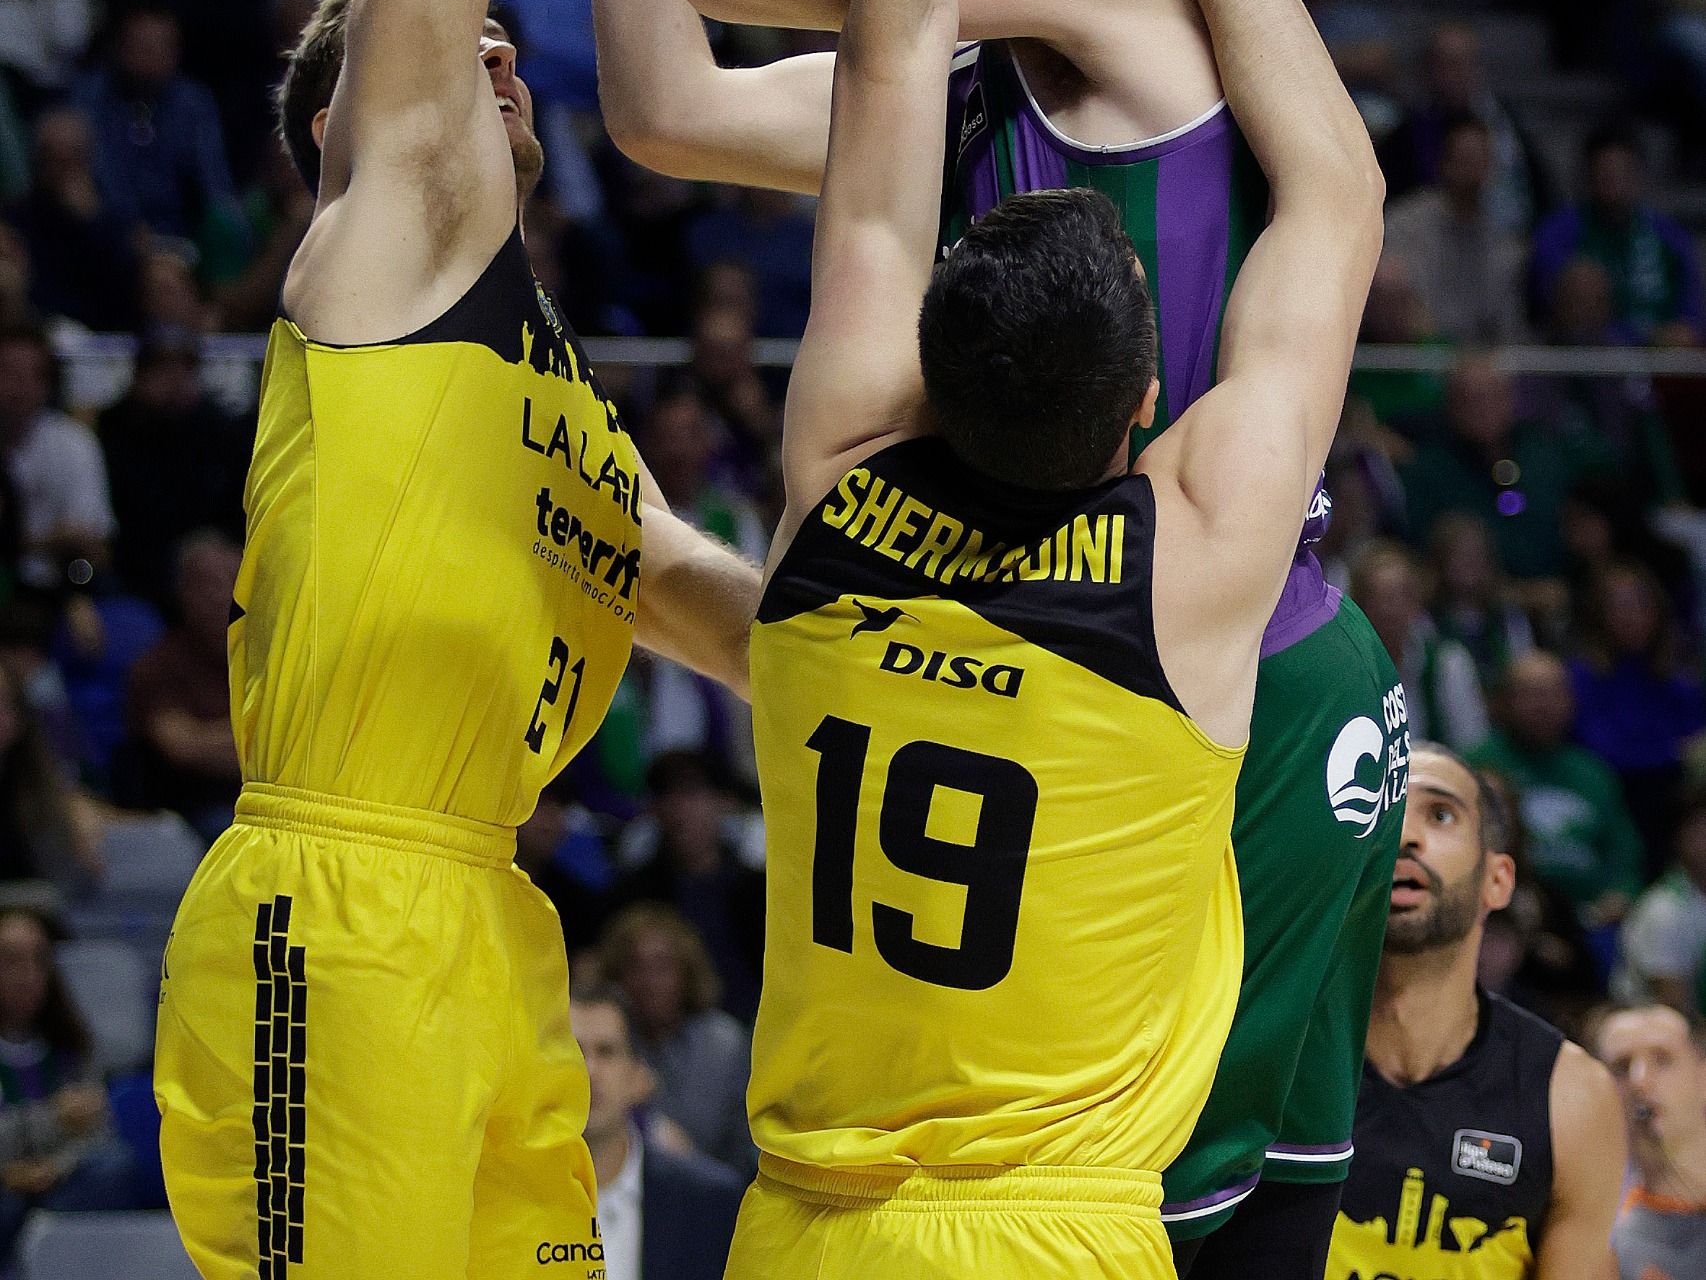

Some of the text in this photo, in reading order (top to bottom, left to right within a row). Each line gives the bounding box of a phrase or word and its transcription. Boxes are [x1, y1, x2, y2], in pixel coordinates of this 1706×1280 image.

[521, 396, 572, 470] LA
[524, 635, 585, 754] 21
[804, 712, 1039, 992] 19
